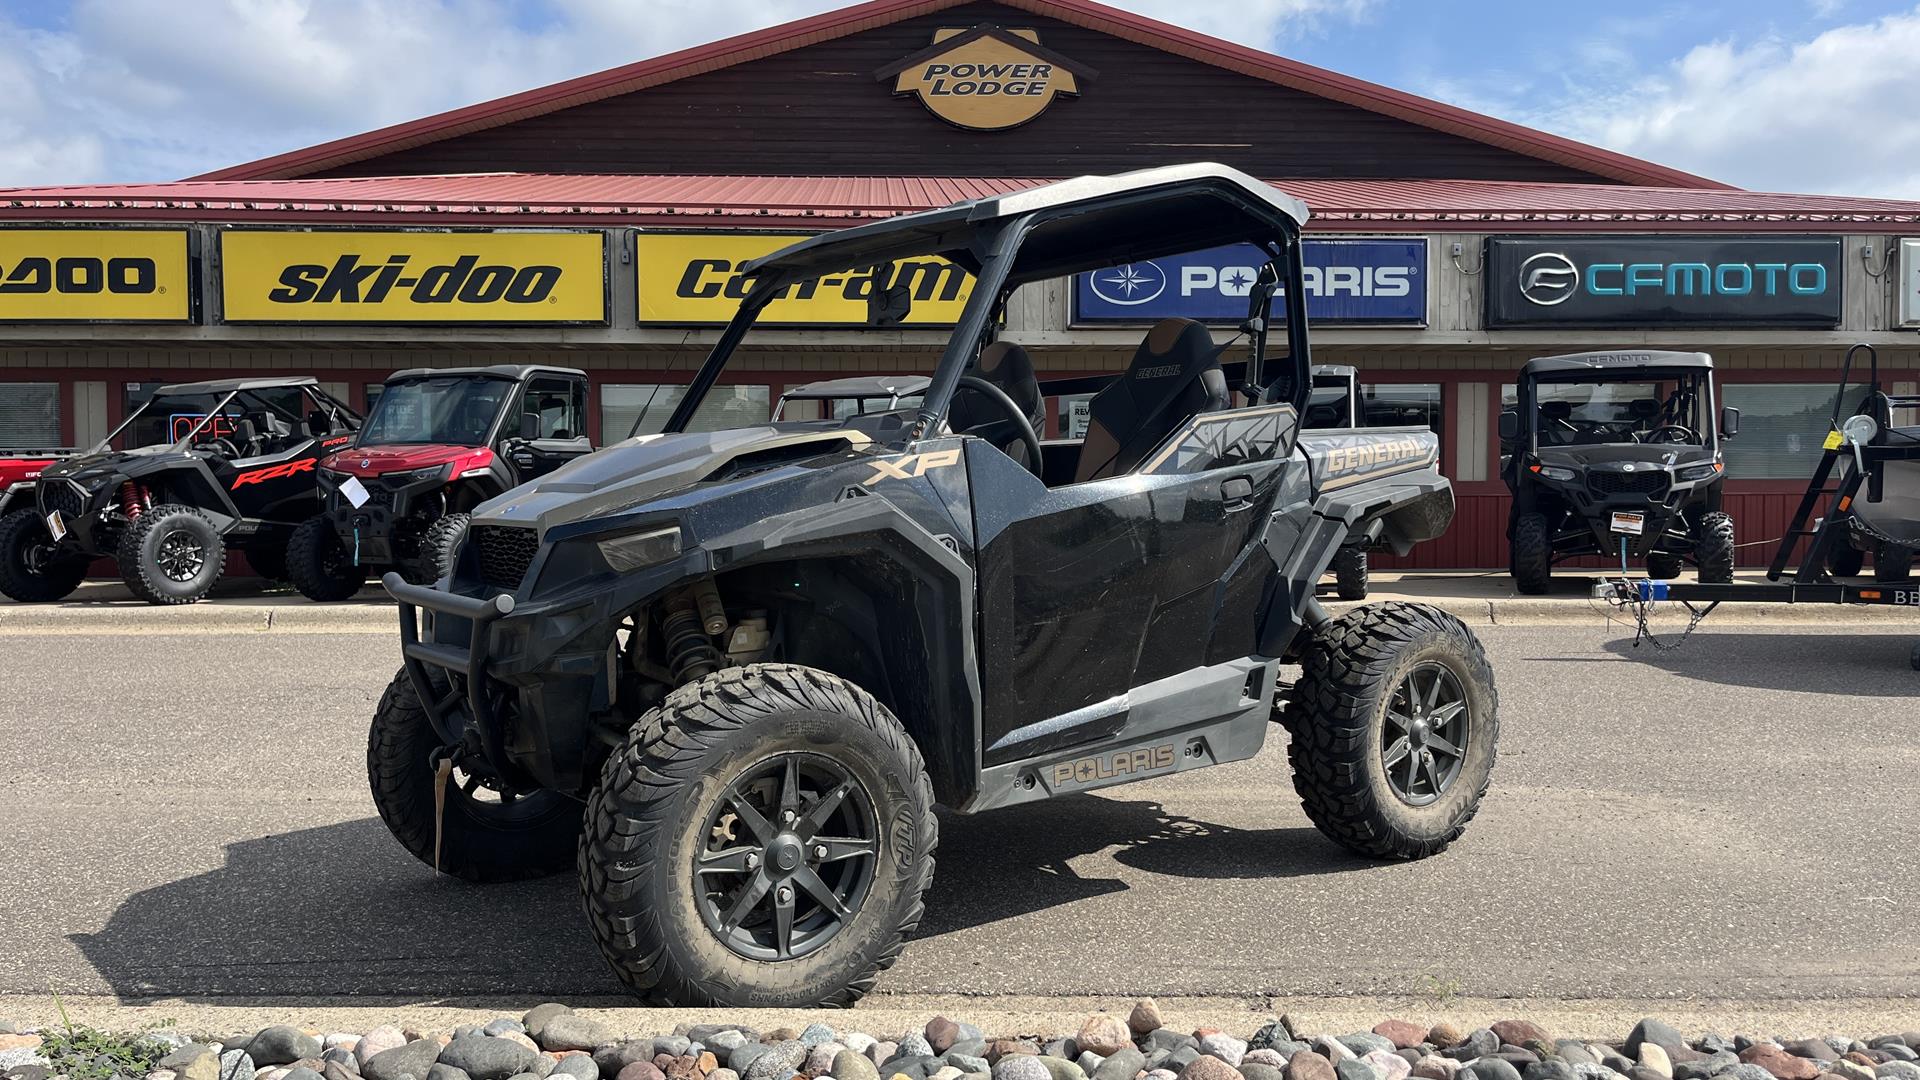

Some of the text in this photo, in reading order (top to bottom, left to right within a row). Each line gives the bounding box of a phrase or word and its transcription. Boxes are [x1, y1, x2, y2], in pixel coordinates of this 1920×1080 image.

[922, 64, 1052, 81] POWER
[929, 79, 1047, 96] LODGE
[269, 254, 563, 304] ski-doo
[1181, 265, 1410, 297] POARIS
[1585, 262, 1828, 297] CFMOTO
[1135, 364, 1182, 380] GENERAL
[1587, 353, 1652, 363] CFMOTO
[173, 416, 240, 444] OPE
[322, 436, 349, 447] PRO
[863, 448, 961, 486] XP
[1327, 438, 1427, 473] GENERAL
[230, 457, 318, 491] RZR
[1053, 743, 1176, 788] POLARIS
[896, 811, 915, 868] ITP
